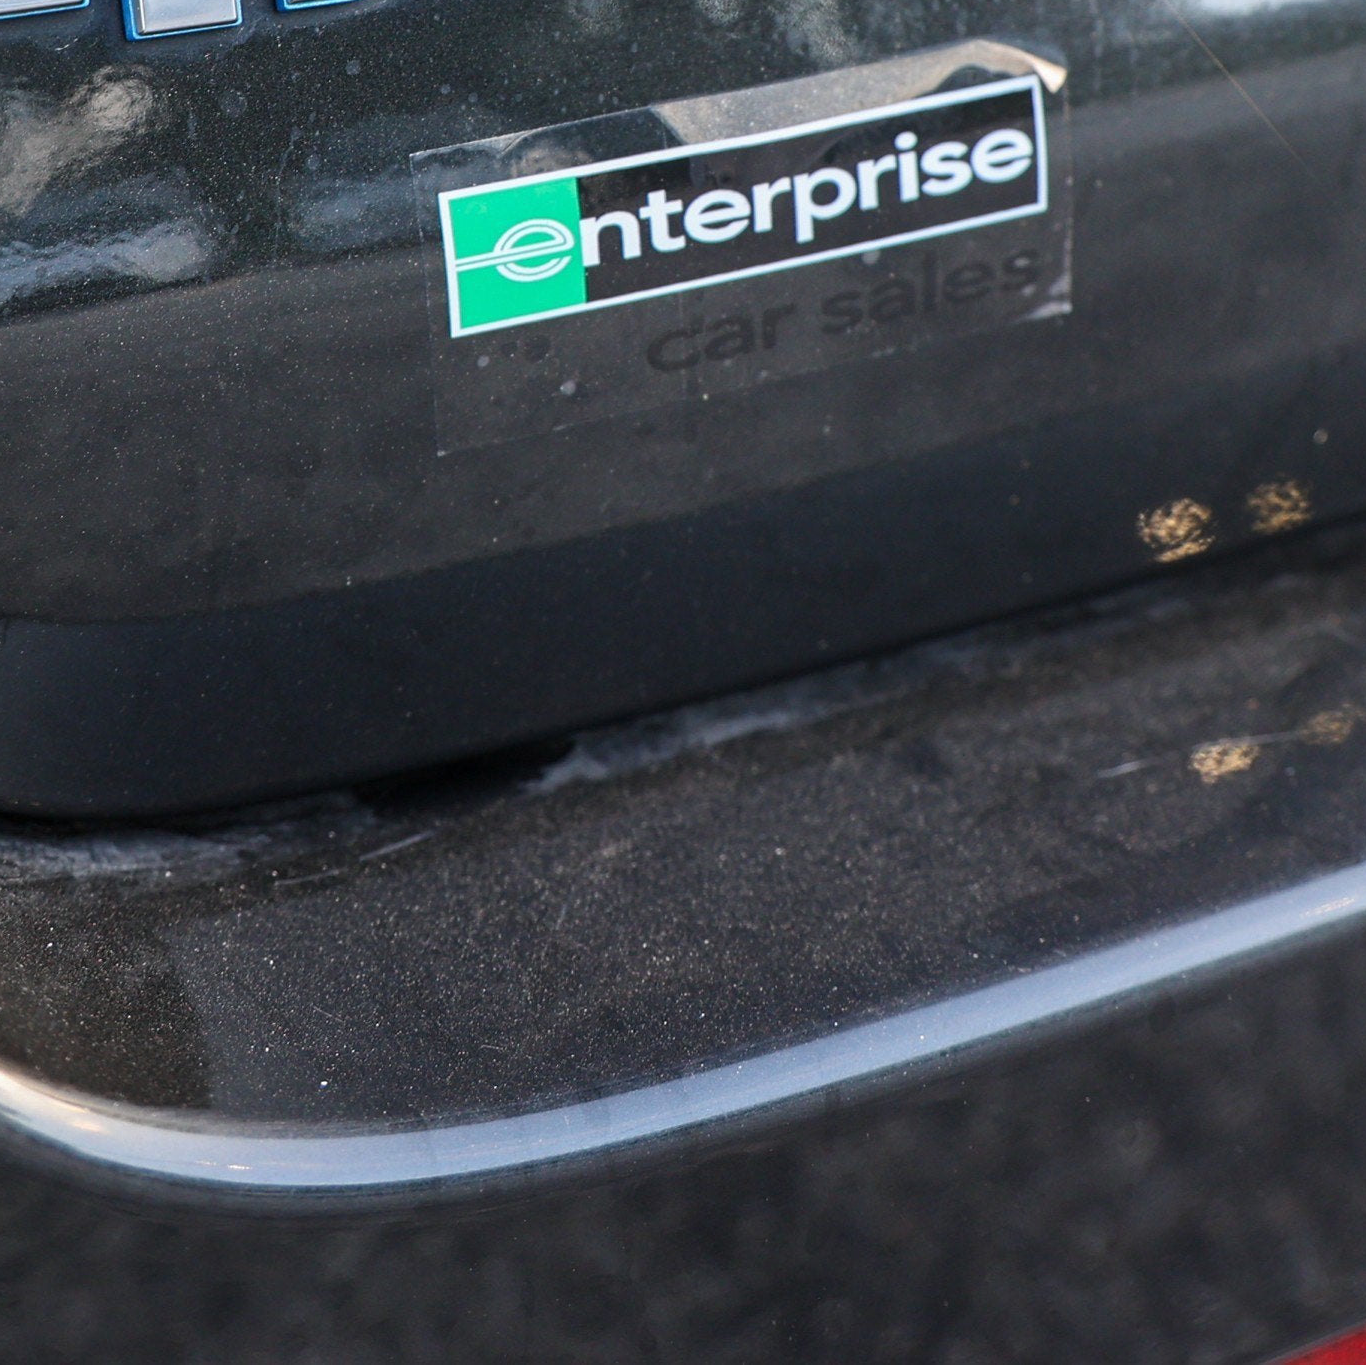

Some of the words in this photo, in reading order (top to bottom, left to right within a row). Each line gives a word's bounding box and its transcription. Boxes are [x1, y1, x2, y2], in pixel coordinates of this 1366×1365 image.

[455, 130, 1035, 283] enterprise
[646, 296, 795, 373] car
[820, 248, 1038, 335] sales
